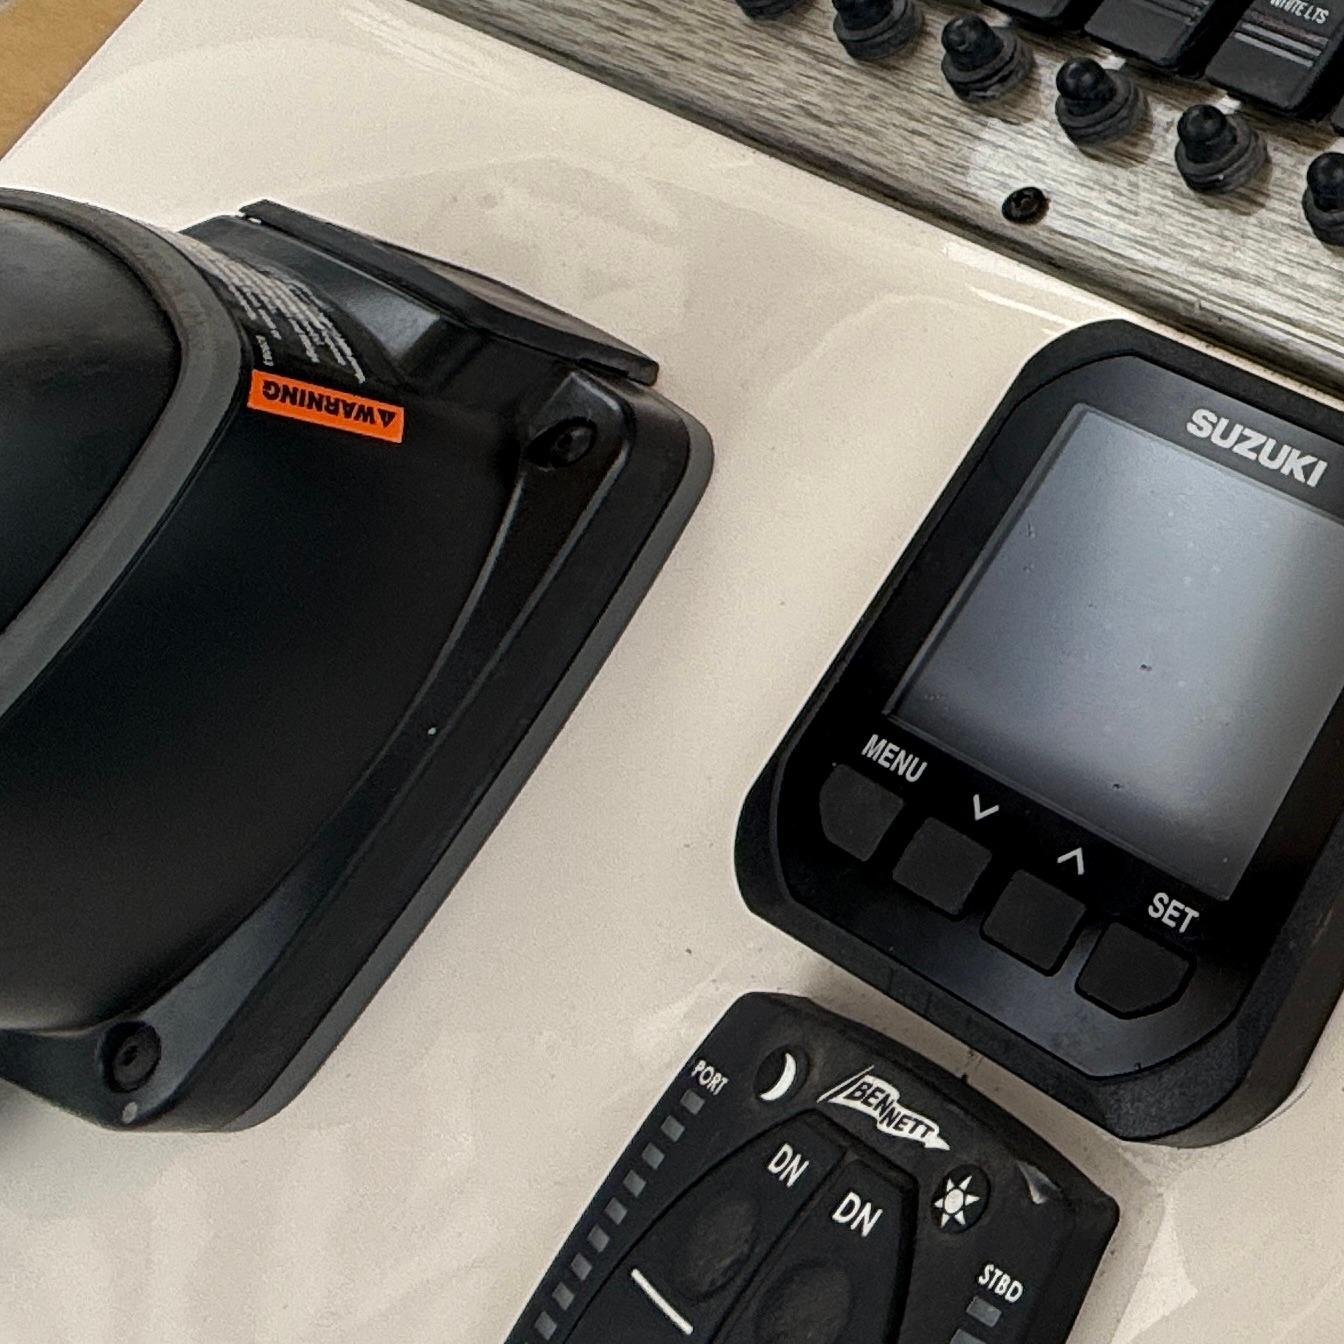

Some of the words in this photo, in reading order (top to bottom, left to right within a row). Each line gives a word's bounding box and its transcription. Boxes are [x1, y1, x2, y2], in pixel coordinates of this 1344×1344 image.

[1303, 5, 1329, 24] LTS
[262, 380, 376, 425] WARNING
[1186, 407, 1329, 488] SUZUKI
[862, 734, 928, 783] MENU
[1148, 892, 1200, 934] SET
[692, 1059, 729, 1094] PORT
[843, 1081, 935, 1138] BENNETT
[768, 1143, 810, 1187] DN
[832, 1192, 883, 1237] DN
[979, 1263, 1024, 1303] STBD
